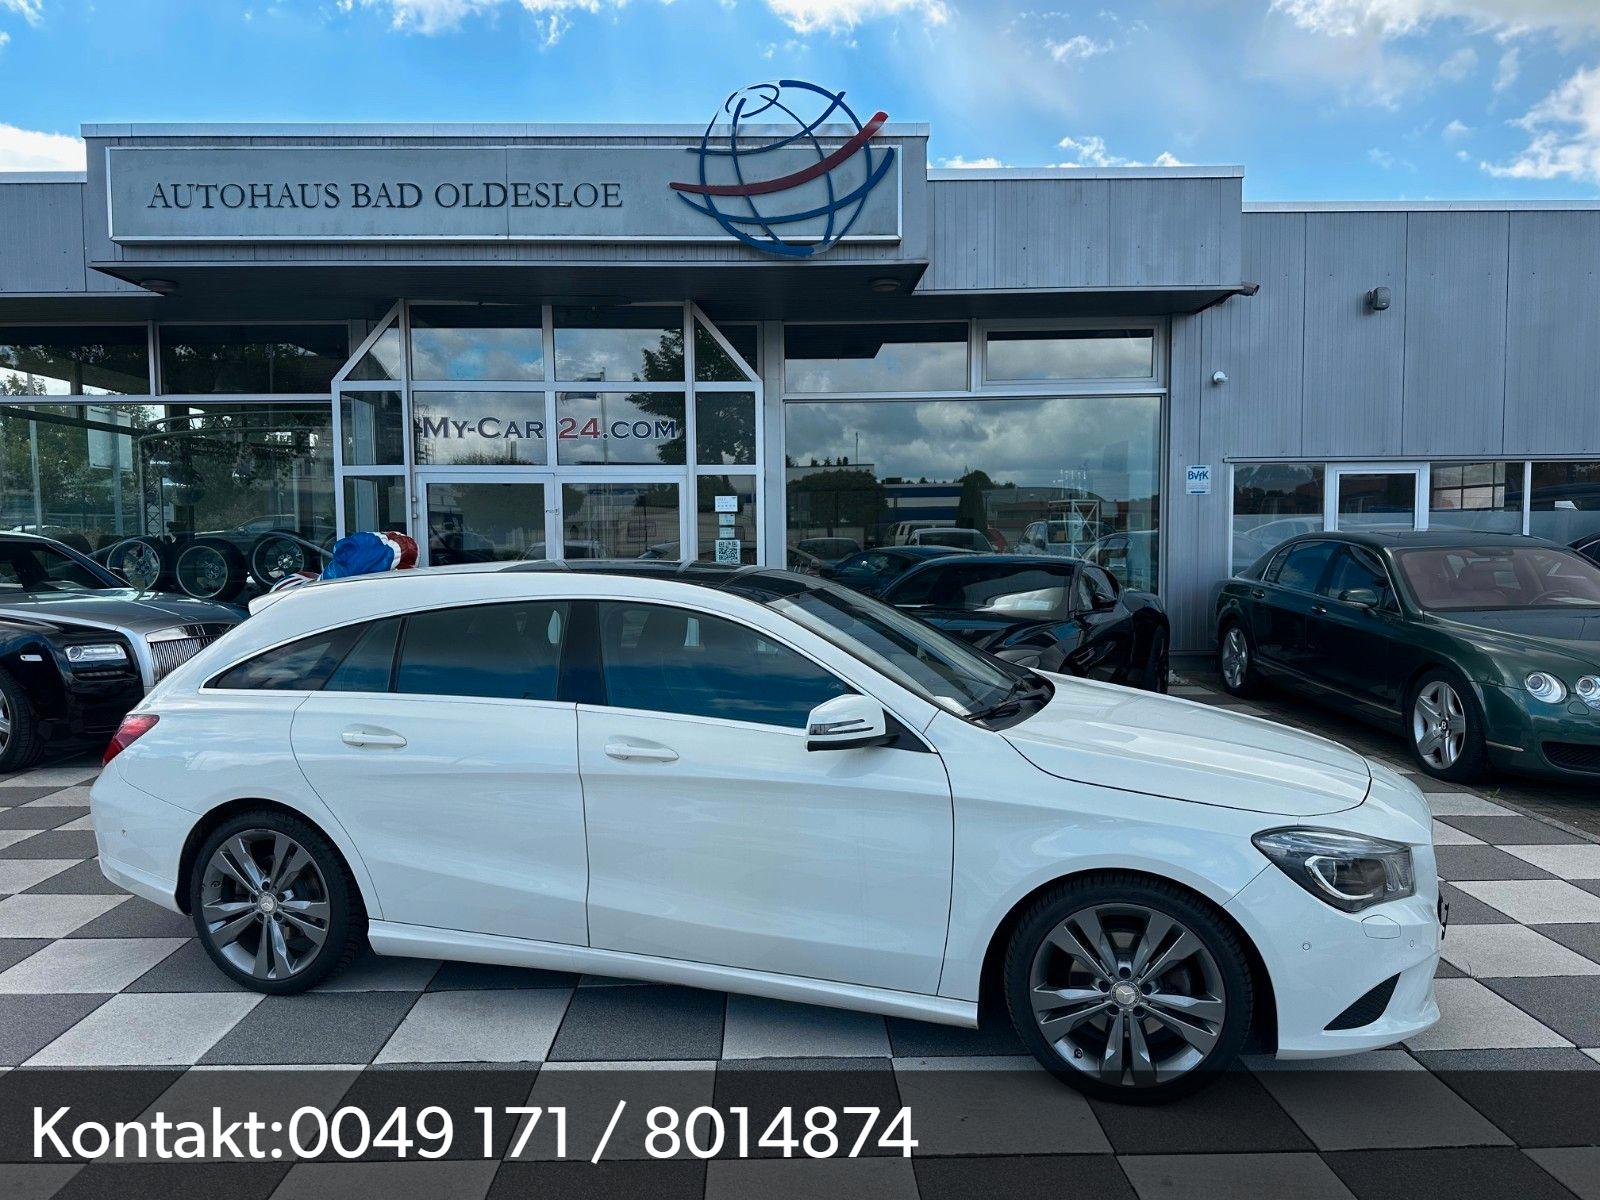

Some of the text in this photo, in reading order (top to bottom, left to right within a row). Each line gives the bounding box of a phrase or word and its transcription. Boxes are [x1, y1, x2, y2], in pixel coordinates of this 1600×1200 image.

[147, 181, 623, 209] AUTOHAUS BAD OLDESLOE
